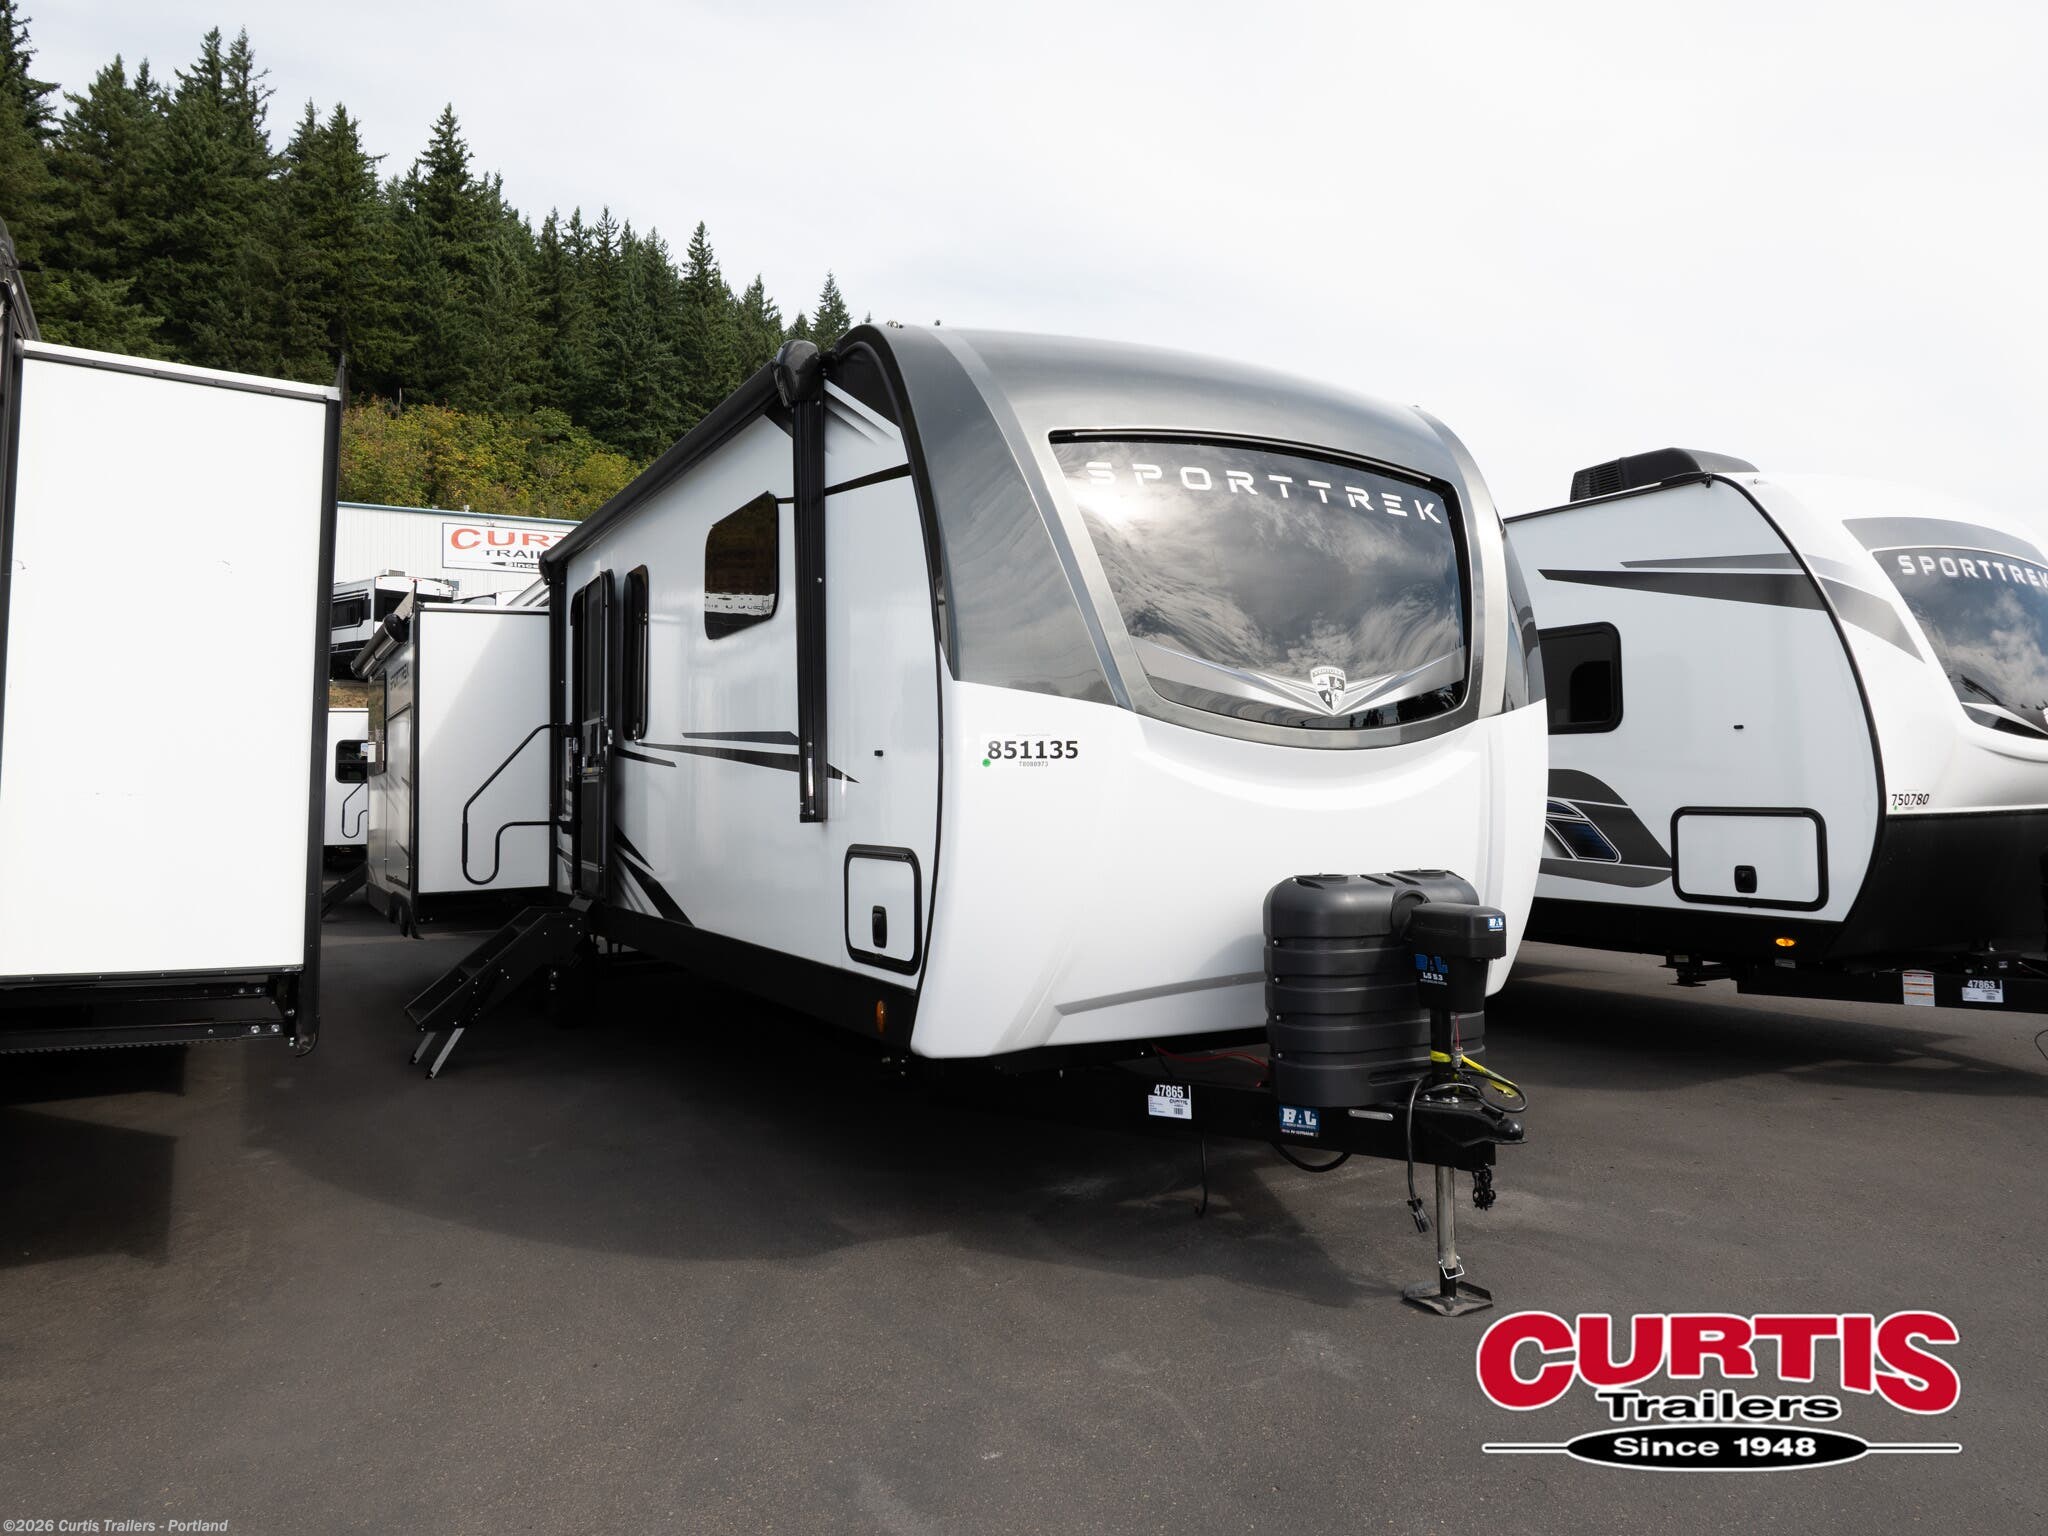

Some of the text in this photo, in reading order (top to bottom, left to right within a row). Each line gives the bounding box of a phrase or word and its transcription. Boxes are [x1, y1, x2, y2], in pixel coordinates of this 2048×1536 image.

[1085, 461, 1442, 524] SPORTTREK
[988, 740, 1079, 759] 851135
[1891, 793, 1930, 806] 750780
[1967, 980, 1995, 989] 47863
[1154, 1084, 1184, 1098] 47865
